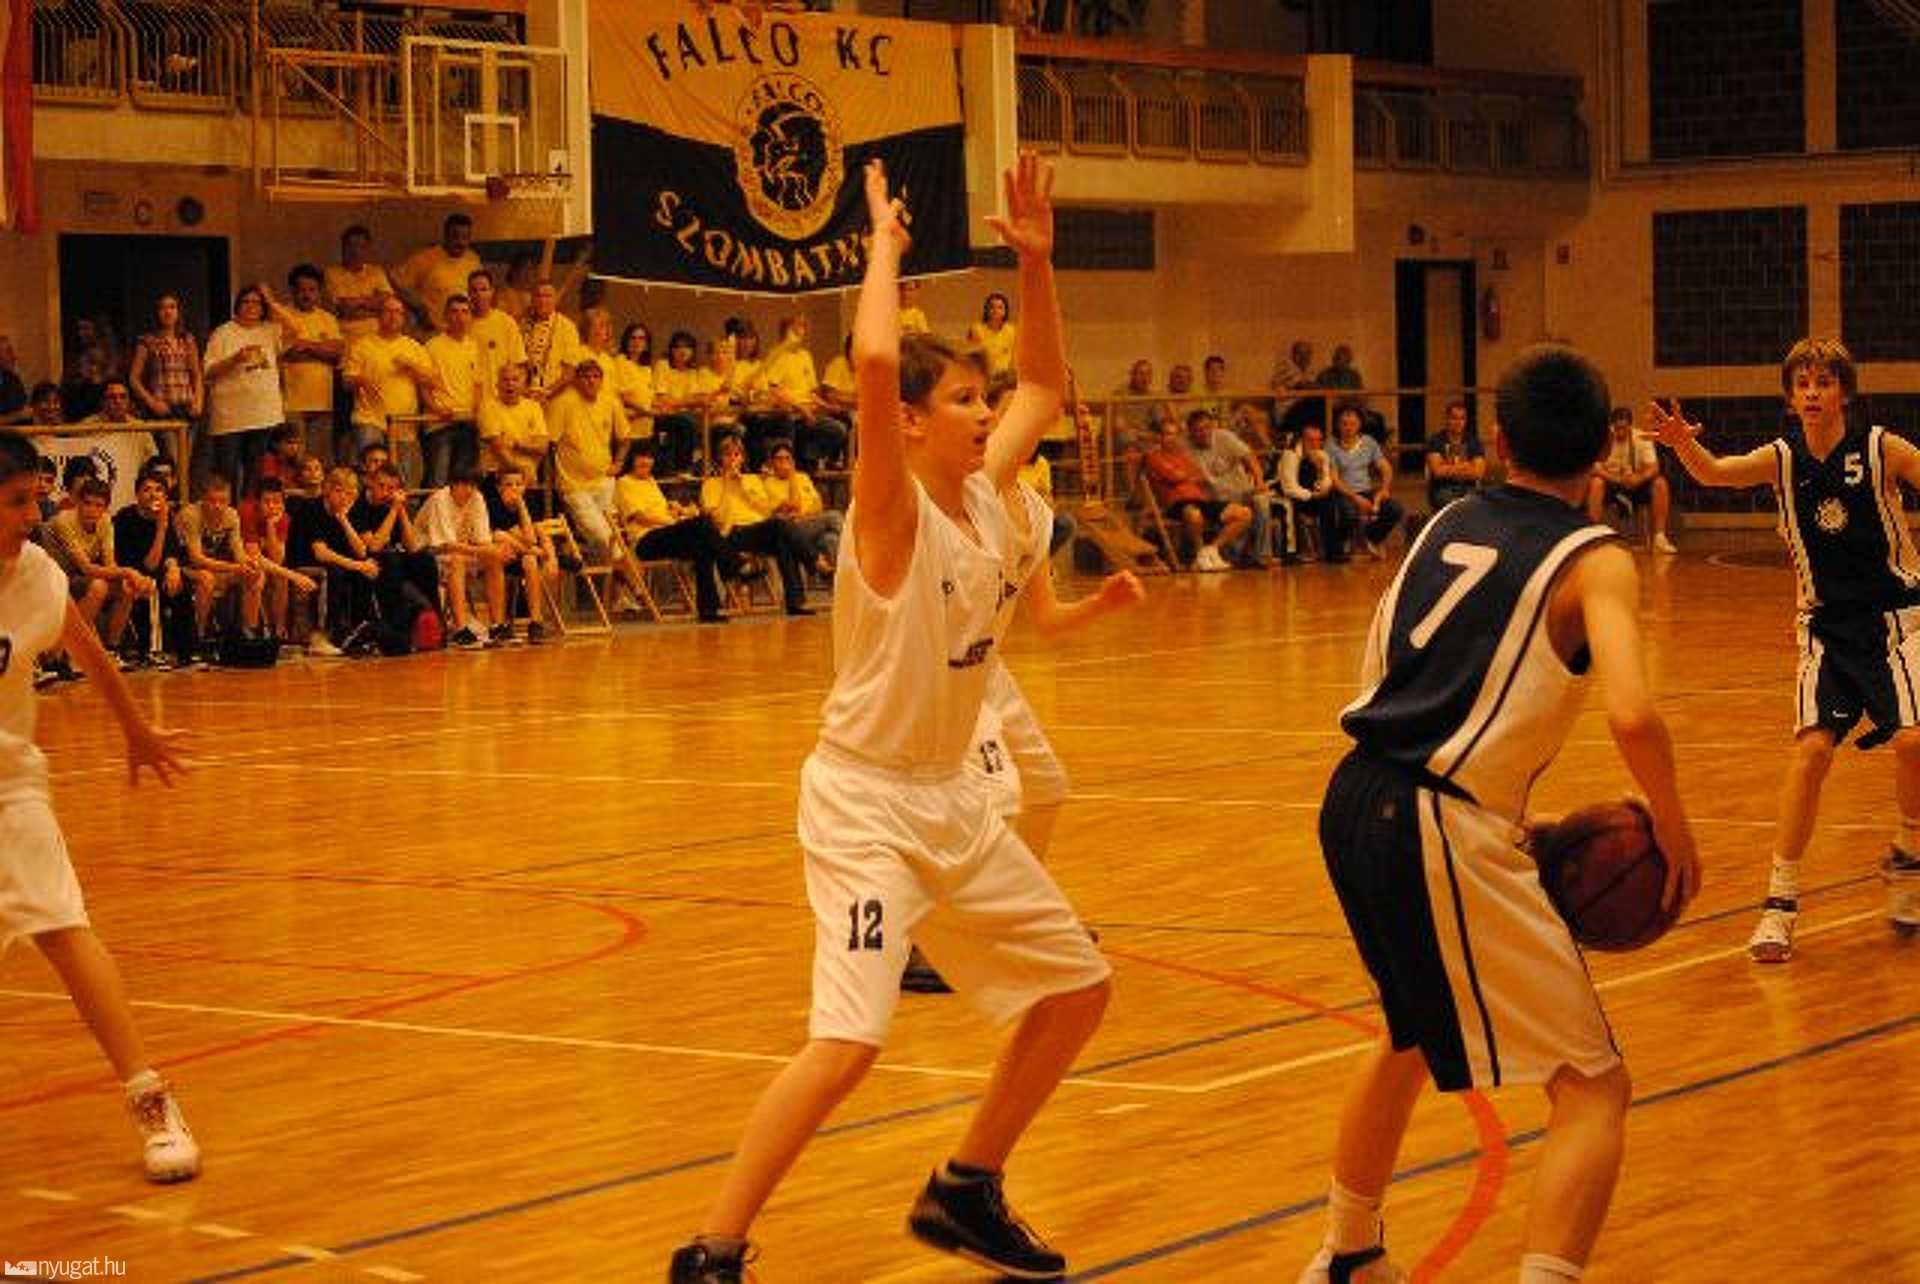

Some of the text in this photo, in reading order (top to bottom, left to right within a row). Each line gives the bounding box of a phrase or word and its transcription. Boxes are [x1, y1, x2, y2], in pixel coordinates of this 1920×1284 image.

[647, 17, 892, 80] FALCO KC
[655, 185, 913, 286] SZOMBATH
[1844, 452, 1863, 486] 5
[1409, 542, 1498, 649] 7
[848, 899, 882, 951] 12
